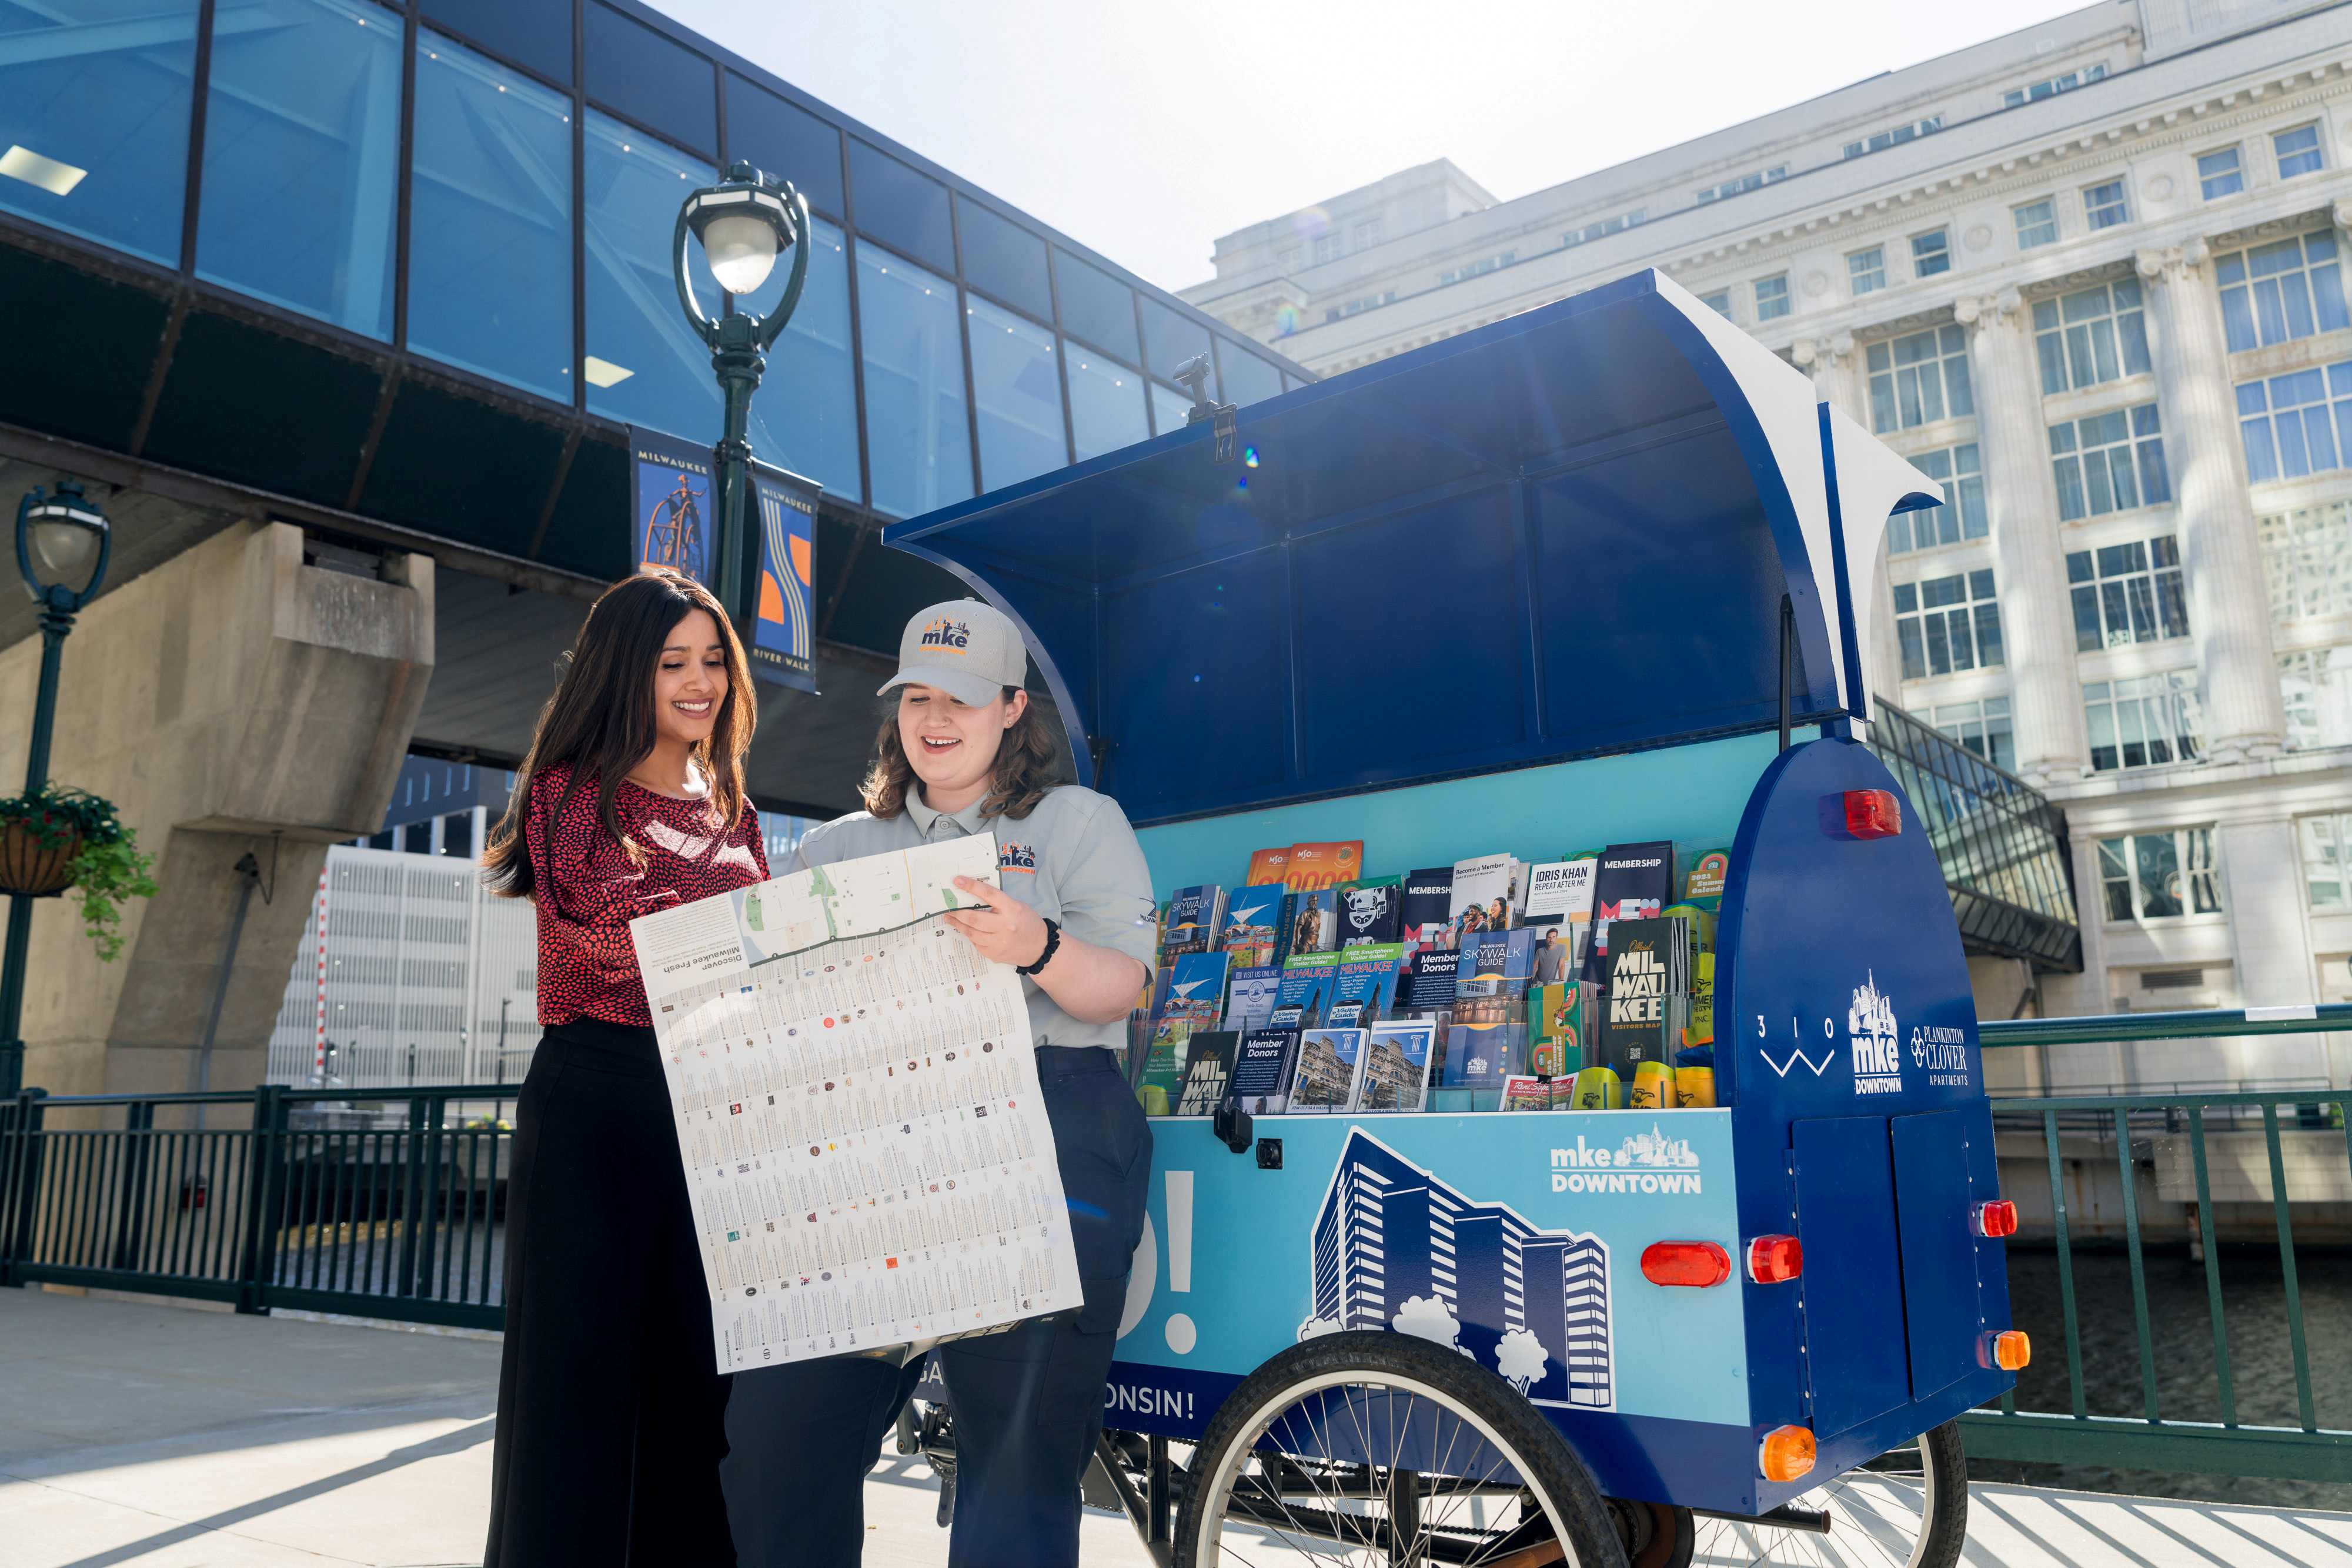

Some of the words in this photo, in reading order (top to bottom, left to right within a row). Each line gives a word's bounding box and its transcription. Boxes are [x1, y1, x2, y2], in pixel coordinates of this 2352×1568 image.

[638, 450, 707, 474] MILWAUKEE
[761, 487, 812, 514] MILWAUKEE
[921, 623, 968, 647] mke
[753, 648, 781, 664] RIVER
[785, 657, 810, 672] WALK
[1297, 850, 1312, 859] MSO
[1605, 858, 1662, 870] MEMBERSHIP
[1536, 870, 1561, 882] IDRIS
[1562, 866, 1588, 880] KHAN
[1535, 882, 1556, 891] REPEAT
[1557, 881, 1576, 890] AFTER
[1172, 899, 1210, 912] SKYWALK
[1180, 909, 1198, 917] GUIDE
[1282, 897, 1292, 937] MUSEUM
[693, 946, 740, 964] Milwaukee
[1464, 947, 1521, 960] SKYWALK
[1629, 940, 1655, 955] Official
[664, 961, 691, 973] Fresh
[702, 954, 742, 970] Discover
[1421, 954, 1460, 964] Member
[1478, 958, 1505, 967] GUIDE
[1613, 951, 1666, 975] MIL
[1282, 967, 1334, 979] MILWAUKEE
[1339, 961, 1393, 975] MILWAUKEE
[1422, 964, 1455, 972] Donors
[1612, 974, 1666, 999] WAU
[1611, 997, 1665, 1023] KEE
[1923, 1026, 1965, 1044] PLANKINTON
[1247, 1039, 1284, 1049] Member
[1248, 1049, 1278, 1058] Donors
[1851, 1035, 1899, 1073] mke
[1926, 1045, 1967, 1071] CLOVER
[1188, 1061, 1227, 1081] MIL
[1468, 1063, 1486, 1071] mke
[1855, 1078, 1902, 1095] DOWNTOWN
[1929, 1075, 1969, 1086] APARTMENTS
[1182, 1081, 1225, 1100] WAU
[1551, 1135, 1612, 1167] mke
[1552, 1174, 1702, 1194] DOWNTOWN
